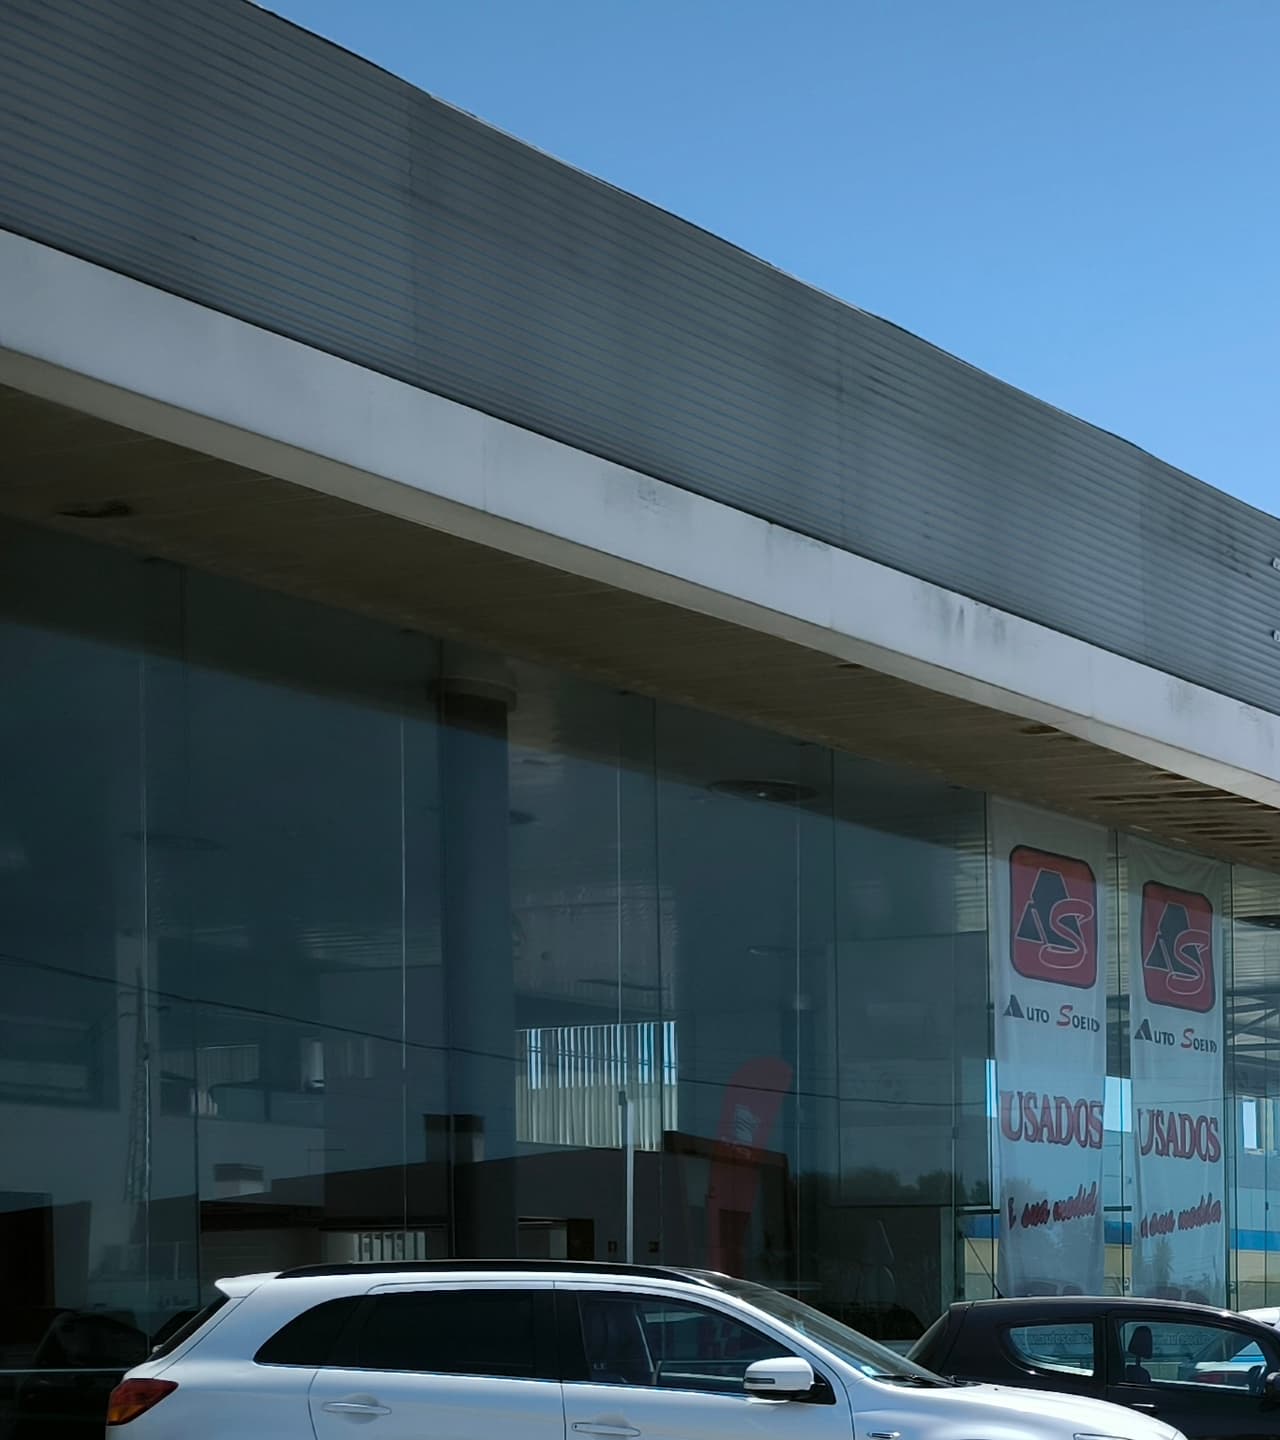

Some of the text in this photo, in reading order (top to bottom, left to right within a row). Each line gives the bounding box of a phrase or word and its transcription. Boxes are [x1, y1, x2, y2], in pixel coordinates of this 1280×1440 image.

[1002, 994, 1050, 1024] AUTO
[1133, 1018, 1176, 1047] AUTO
[1000, 1090, 1104, 1151] USADOS
[1136, 1107, 1222, 1164] USADOS
